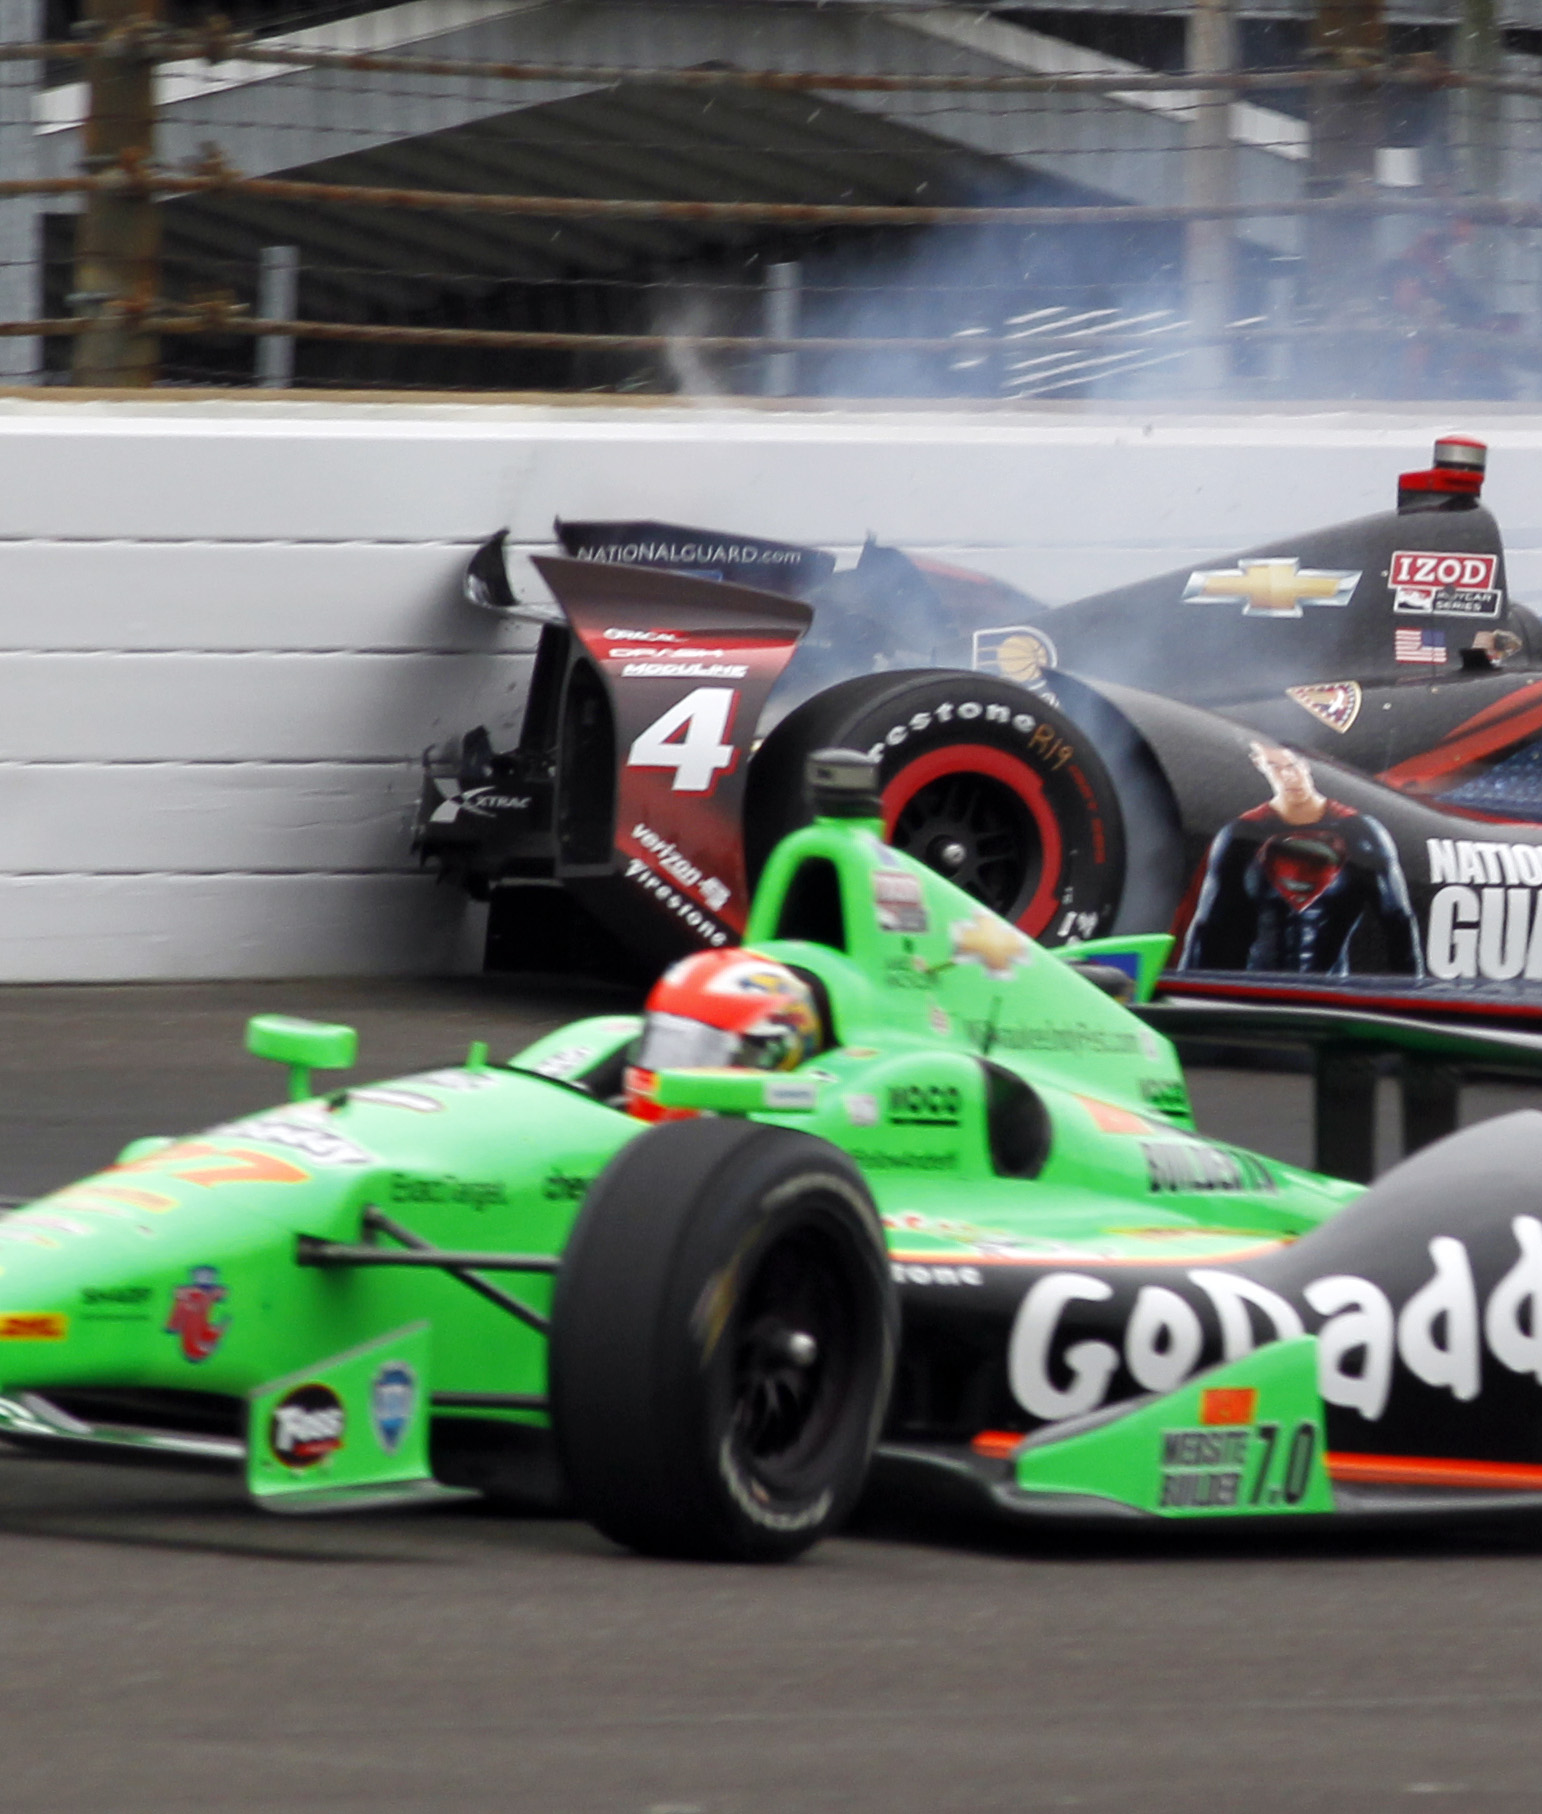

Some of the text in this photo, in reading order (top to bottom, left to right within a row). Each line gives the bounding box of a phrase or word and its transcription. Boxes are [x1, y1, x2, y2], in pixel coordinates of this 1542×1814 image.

[577, 541, 801, 564] NATIONALGUARD.com
[1397, 557, 1487, 586] IZOD
[1434, 601, 1482, 612] SERIES
[626, 686, 735, 793] 4
[631, 821, 704, 888] verizon
[624, 857, 728, 947] Firestone
